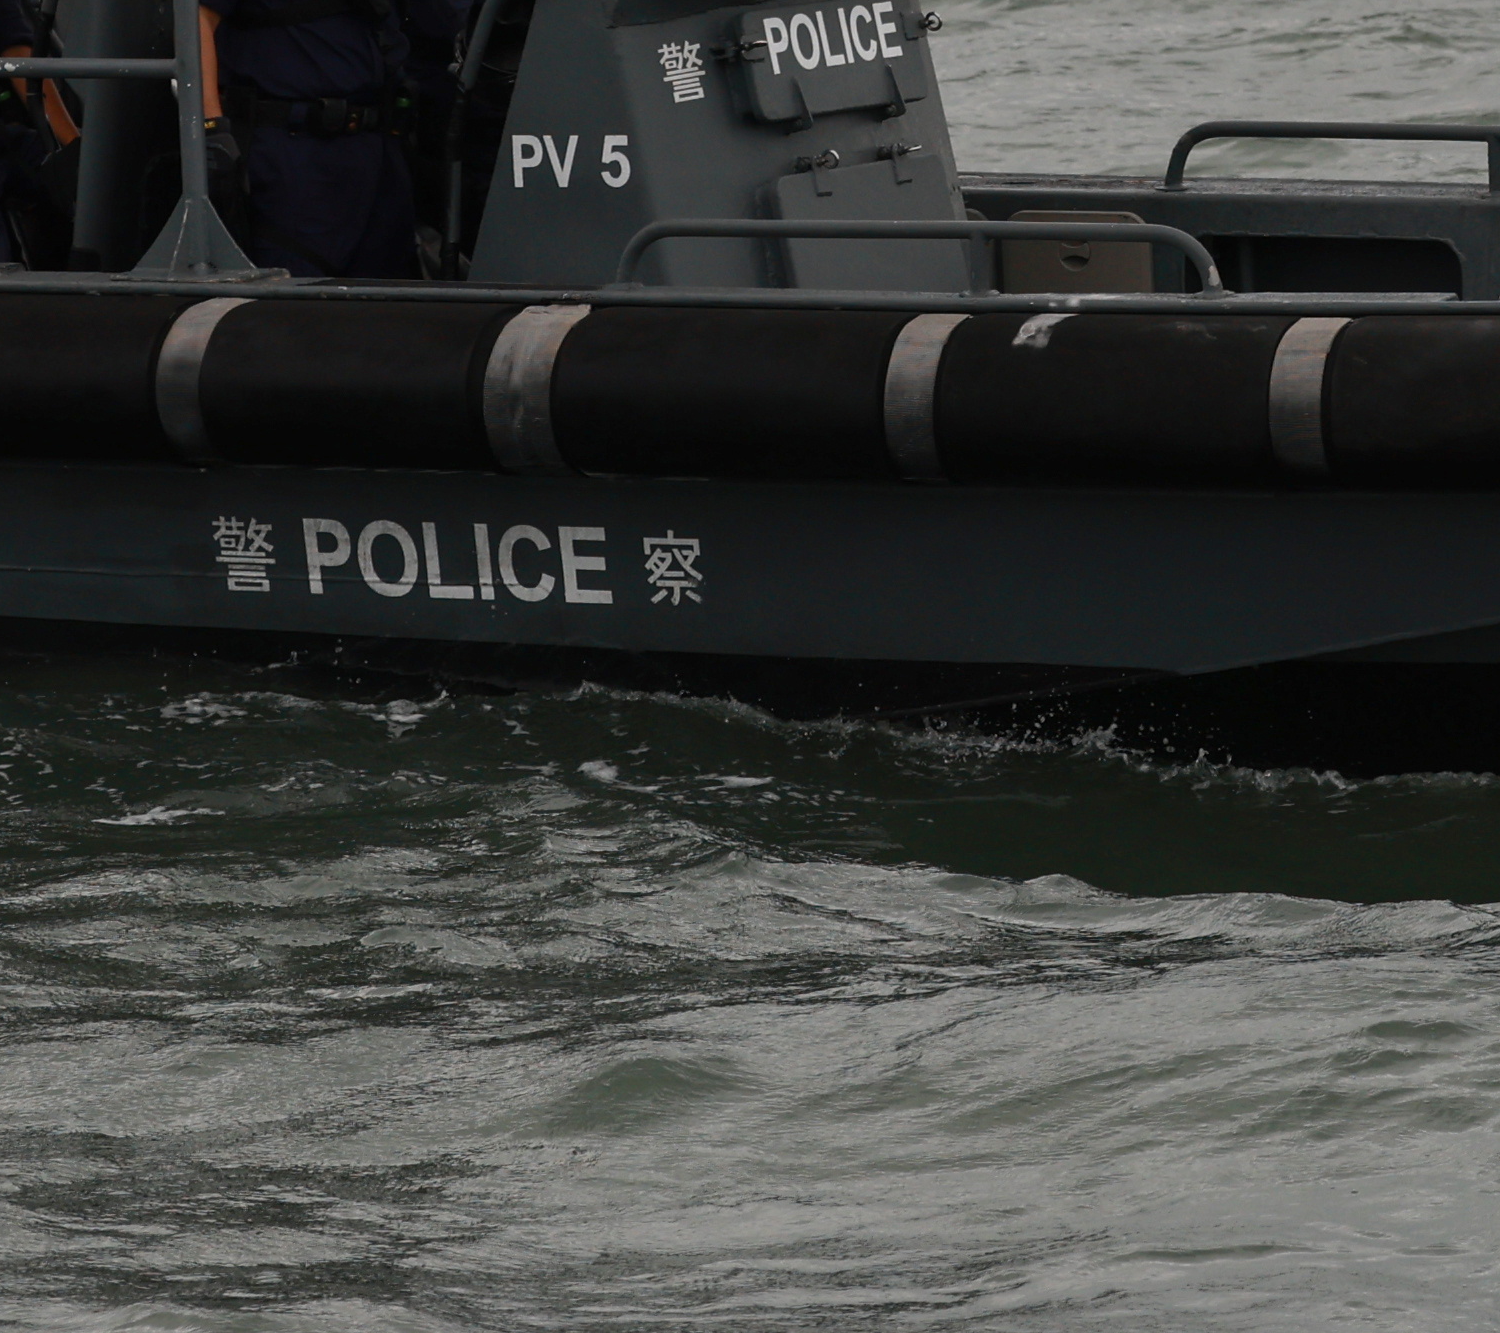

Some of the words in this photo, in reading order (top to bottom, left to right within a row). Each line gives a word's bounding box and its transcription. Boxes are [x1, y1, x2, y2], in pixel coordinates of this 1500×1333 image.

[657, 40, 706, 104] 警
[763, 1, 903, 75] POLICE
[511, 134, 579, 188] PV
[600, 134, 631, 188] 5
[212, 516, 276, 593] 警
[302, 517, 614, 605] POLICE
[642, 530, 704, 607] 察
